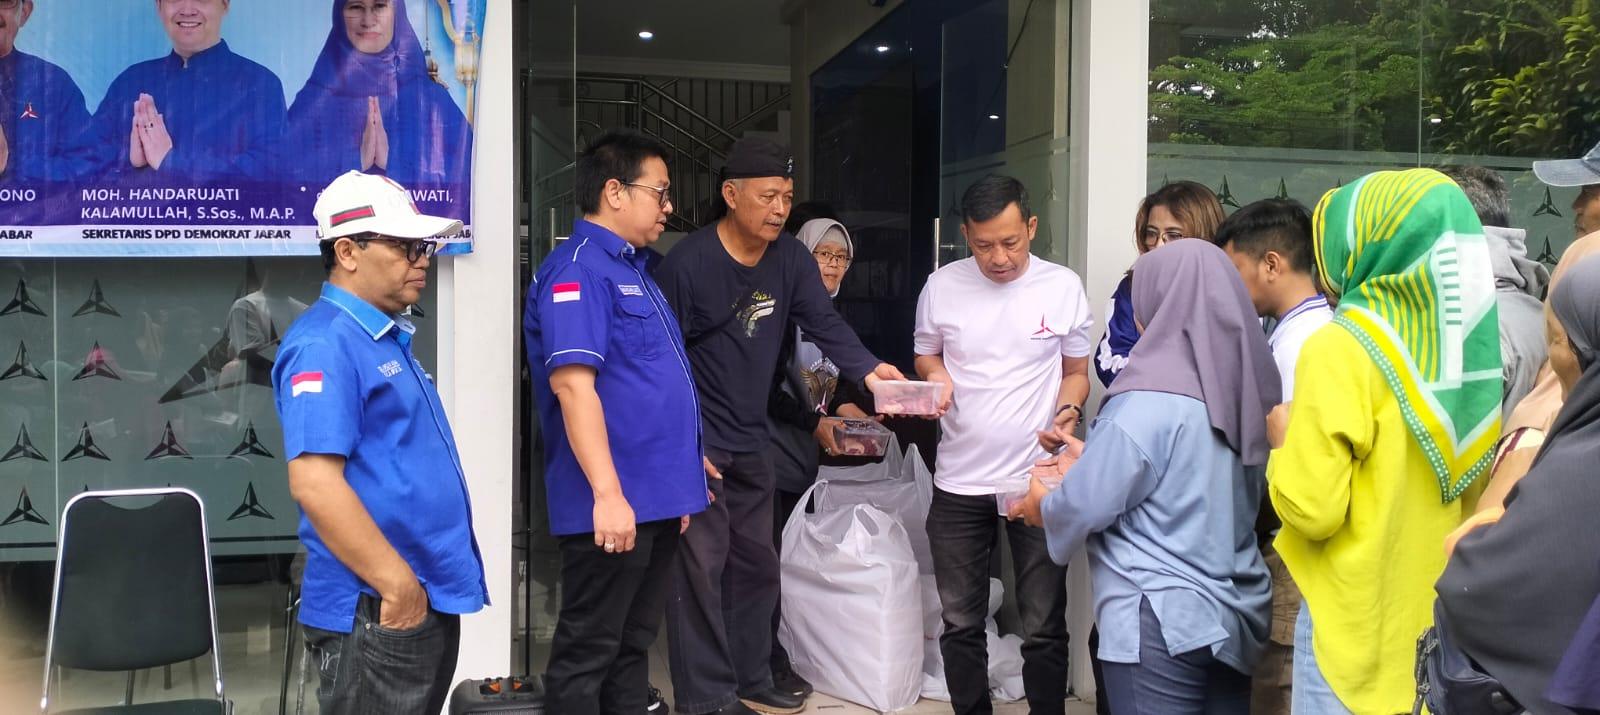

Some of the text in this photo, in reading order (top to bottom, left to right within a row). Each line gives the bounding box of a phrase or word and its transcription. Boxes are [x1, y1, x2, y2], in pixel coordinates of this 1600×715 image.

[0, 189, 36, 201] ONO
[82, 188, 240, 201] MOH. HANDARUJATI
[81, 206, 296, 221] KALAMULLAH, S.Sos., M.A.P.
[82, 229, 292, 239] SEKRETARIS DPD DEMOKRAT JABAR
